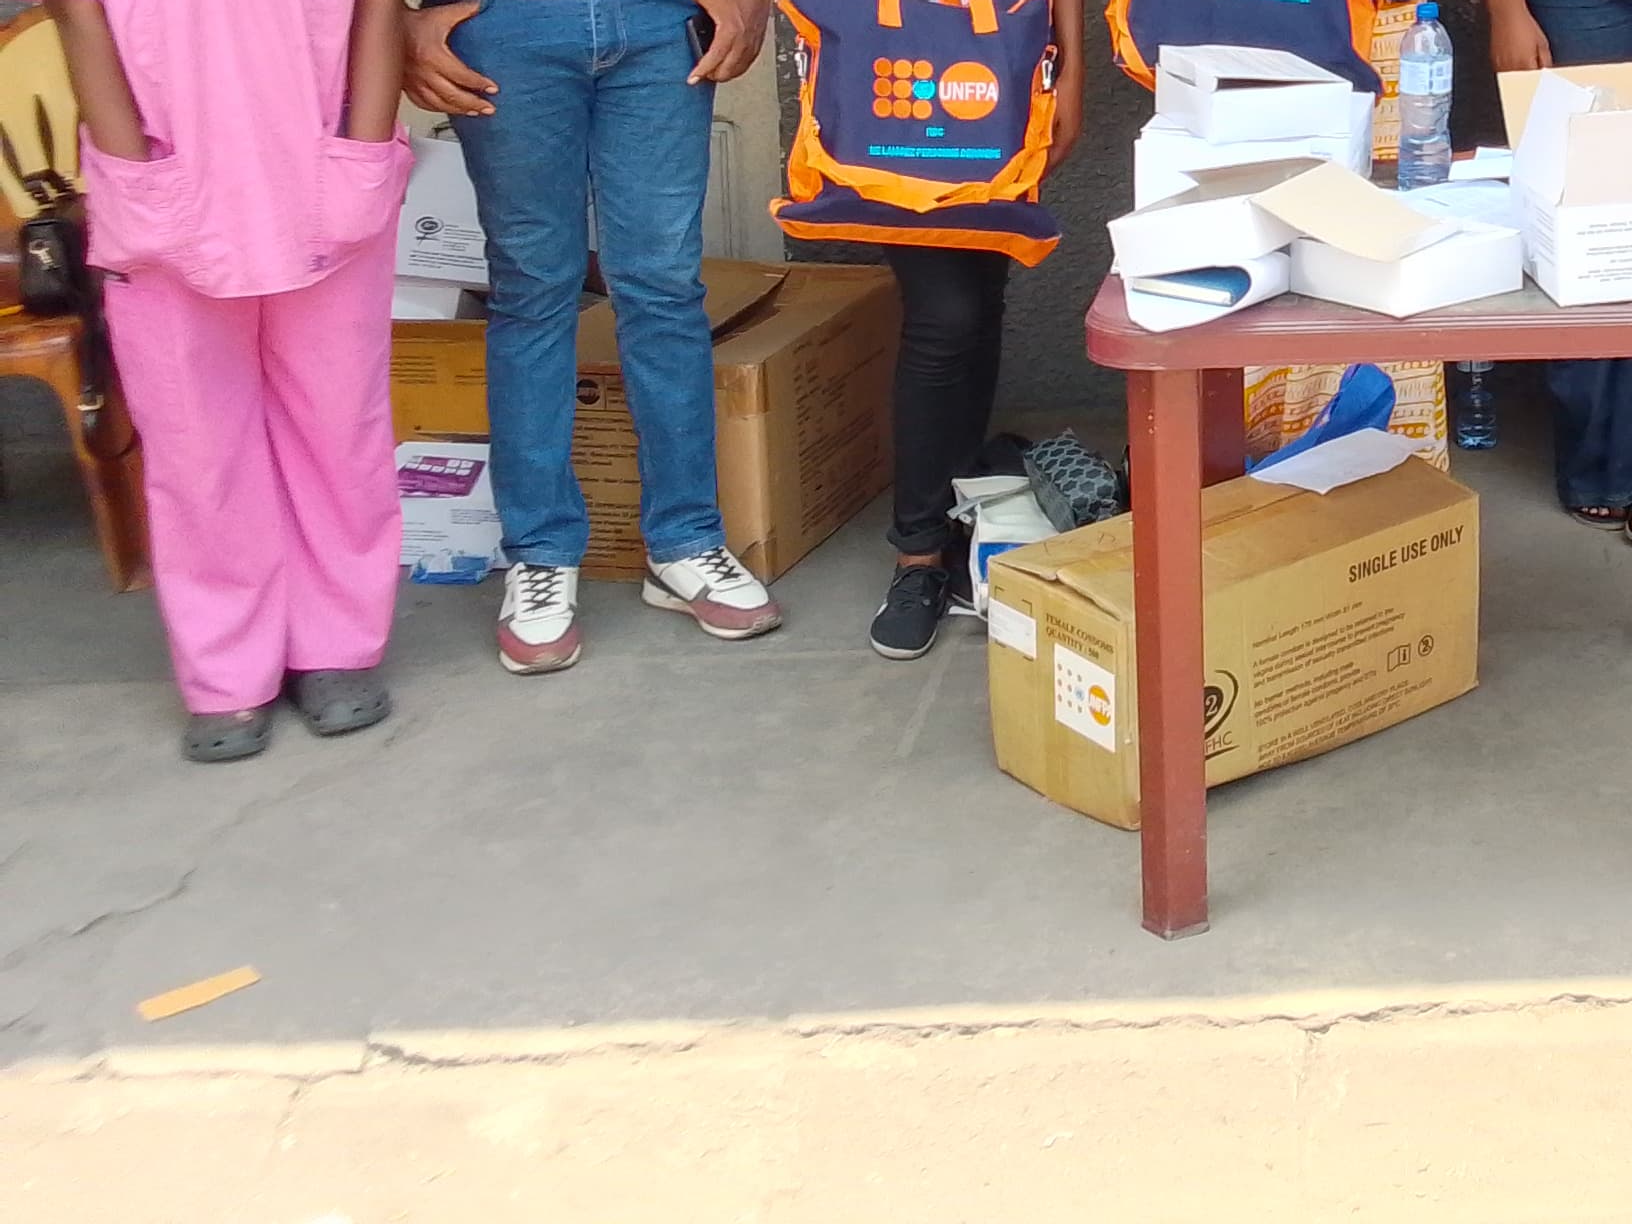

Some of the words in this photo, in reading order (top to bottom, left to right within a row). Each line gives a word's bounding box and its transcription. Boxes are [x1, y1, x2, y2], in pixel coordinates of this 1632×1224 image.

[938, 78, 999, 103] UNFPA
[1348, 549, 1397, 583] SINGLE
[1401, 538, 1428, 564] USE
[1430, 524, 1465, 552] ONLY
